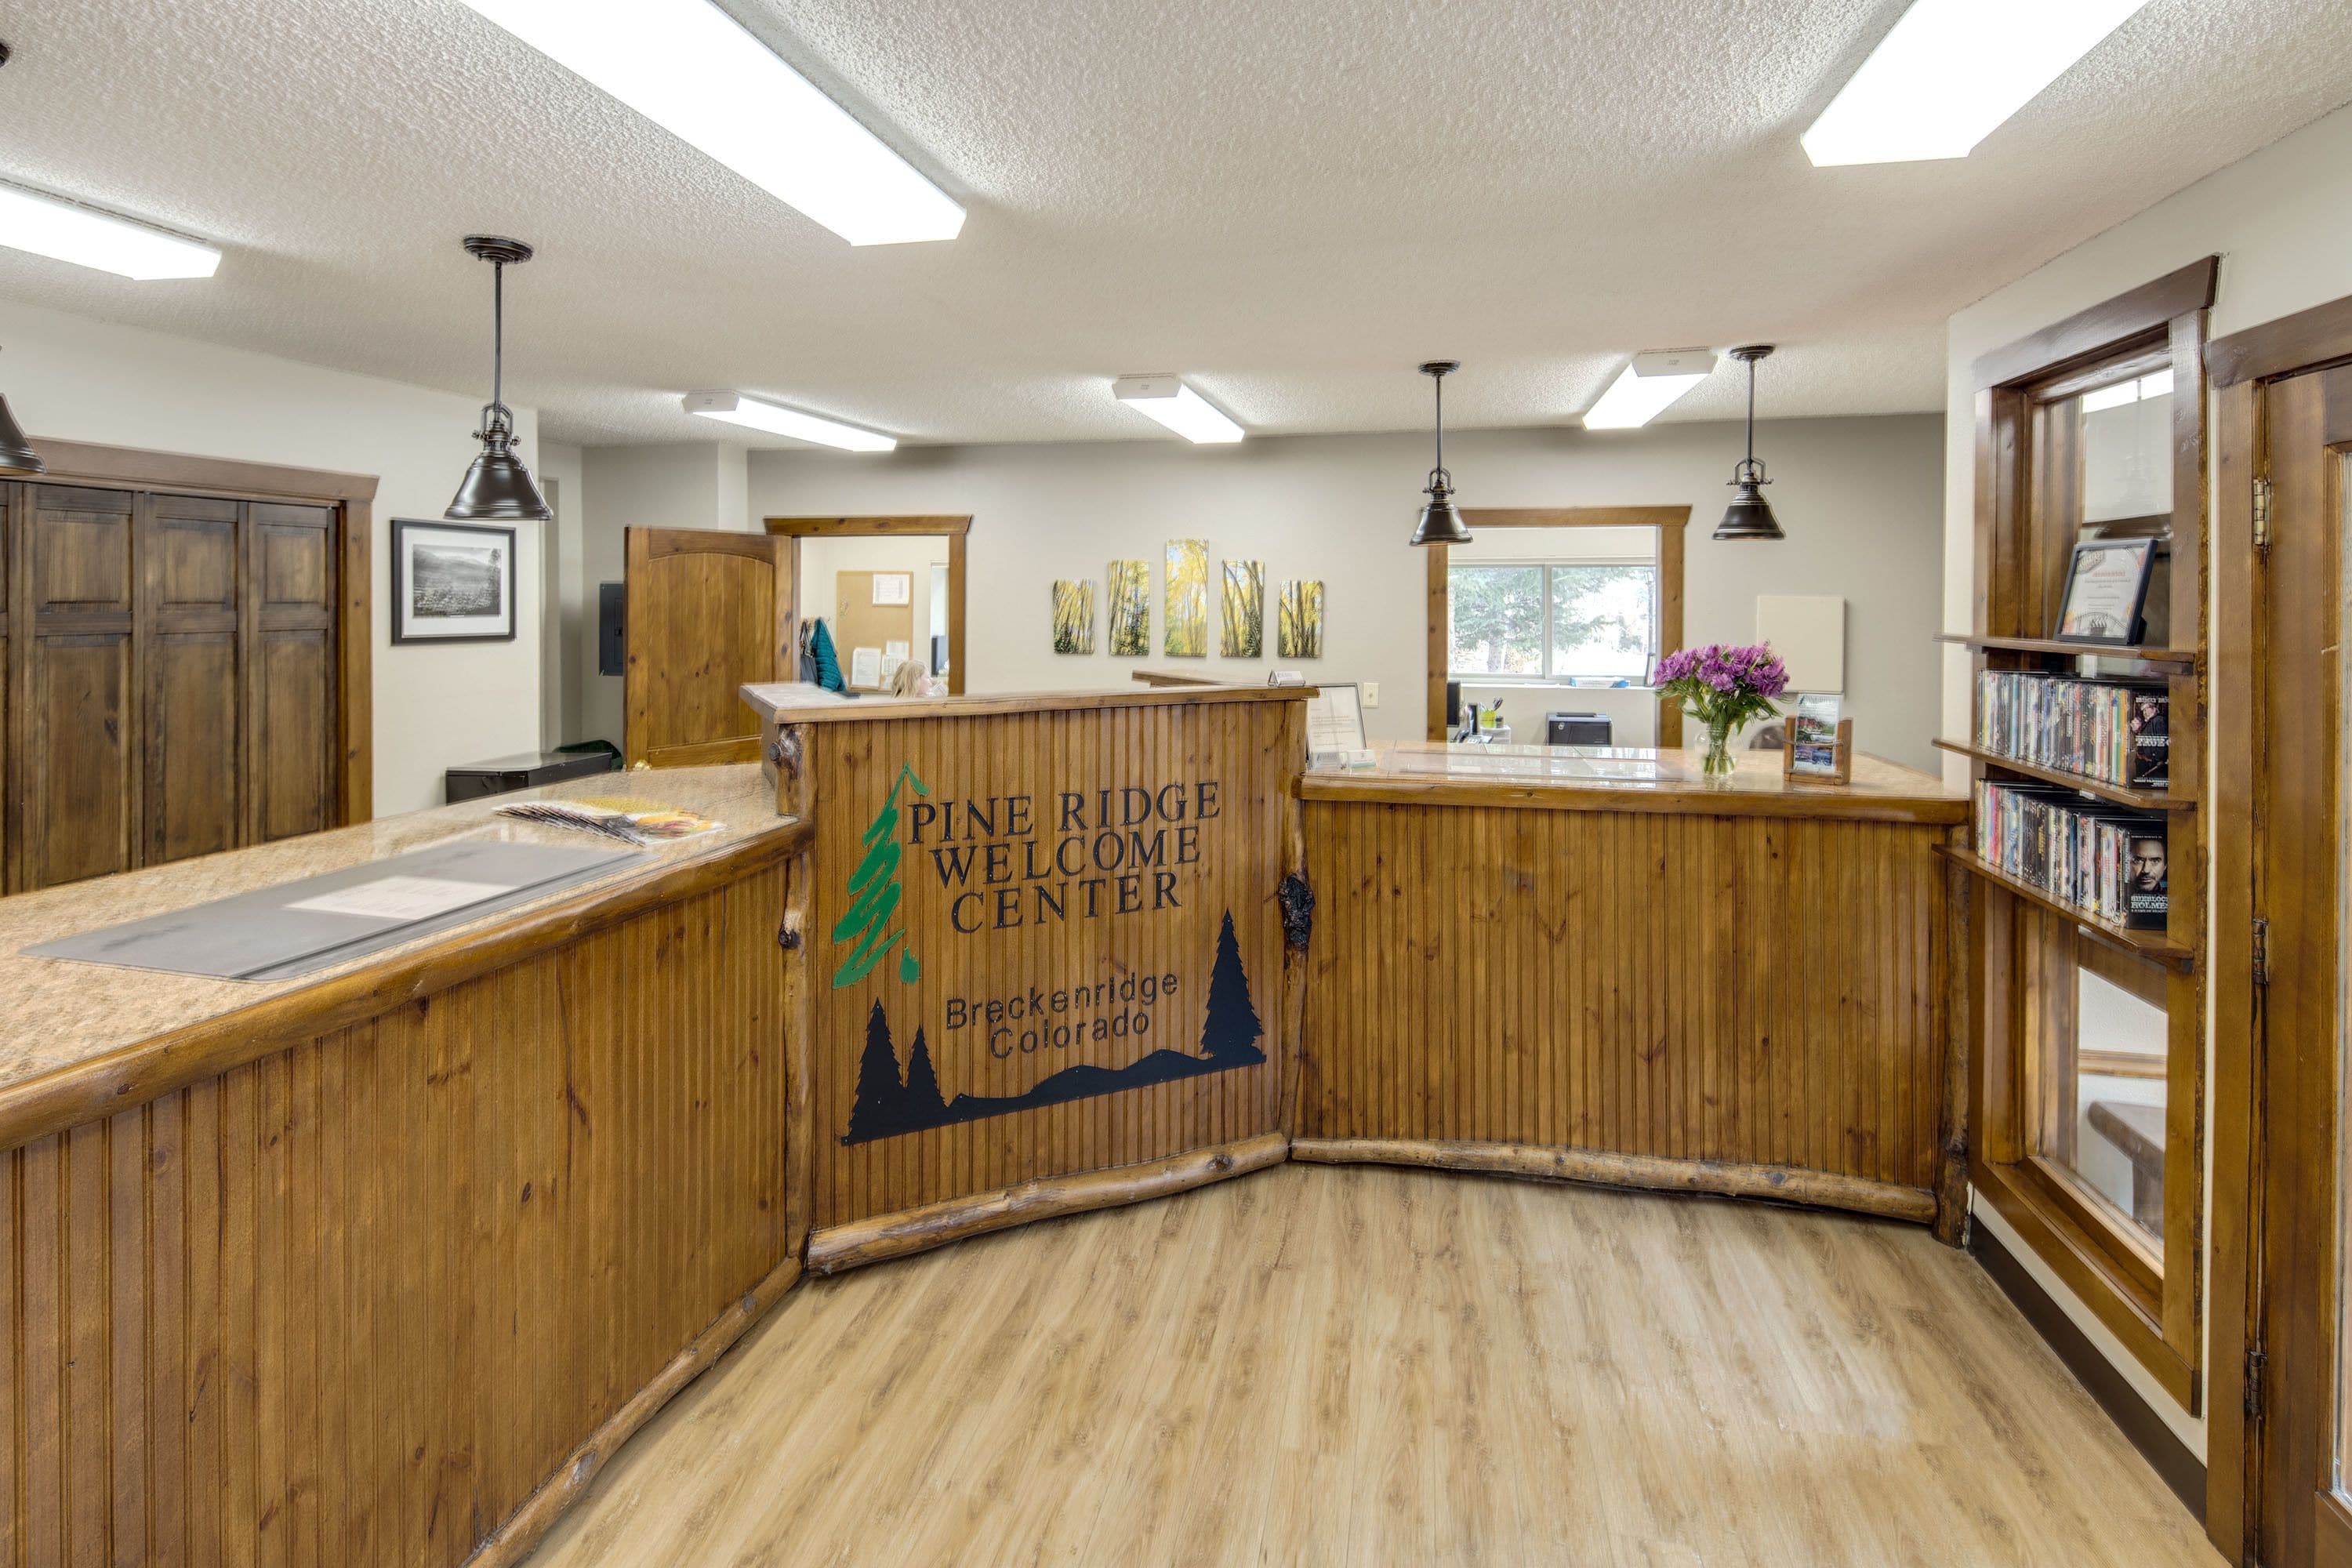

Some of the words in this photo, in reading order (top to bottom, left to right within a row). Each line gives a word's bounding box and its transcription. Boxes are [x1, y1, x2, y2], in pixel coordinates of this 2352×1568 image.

[908, 796, 1033, 844] PINE
[1058, 782, 1220, 831] RIDGE
[928, 826, 1200, 888] WELCOME
[951, 872, 1181, 933] CENTER
[946, 972, 1178, 1029] Breckenridge
[990, 1007, 1149, 1058] Colorado
